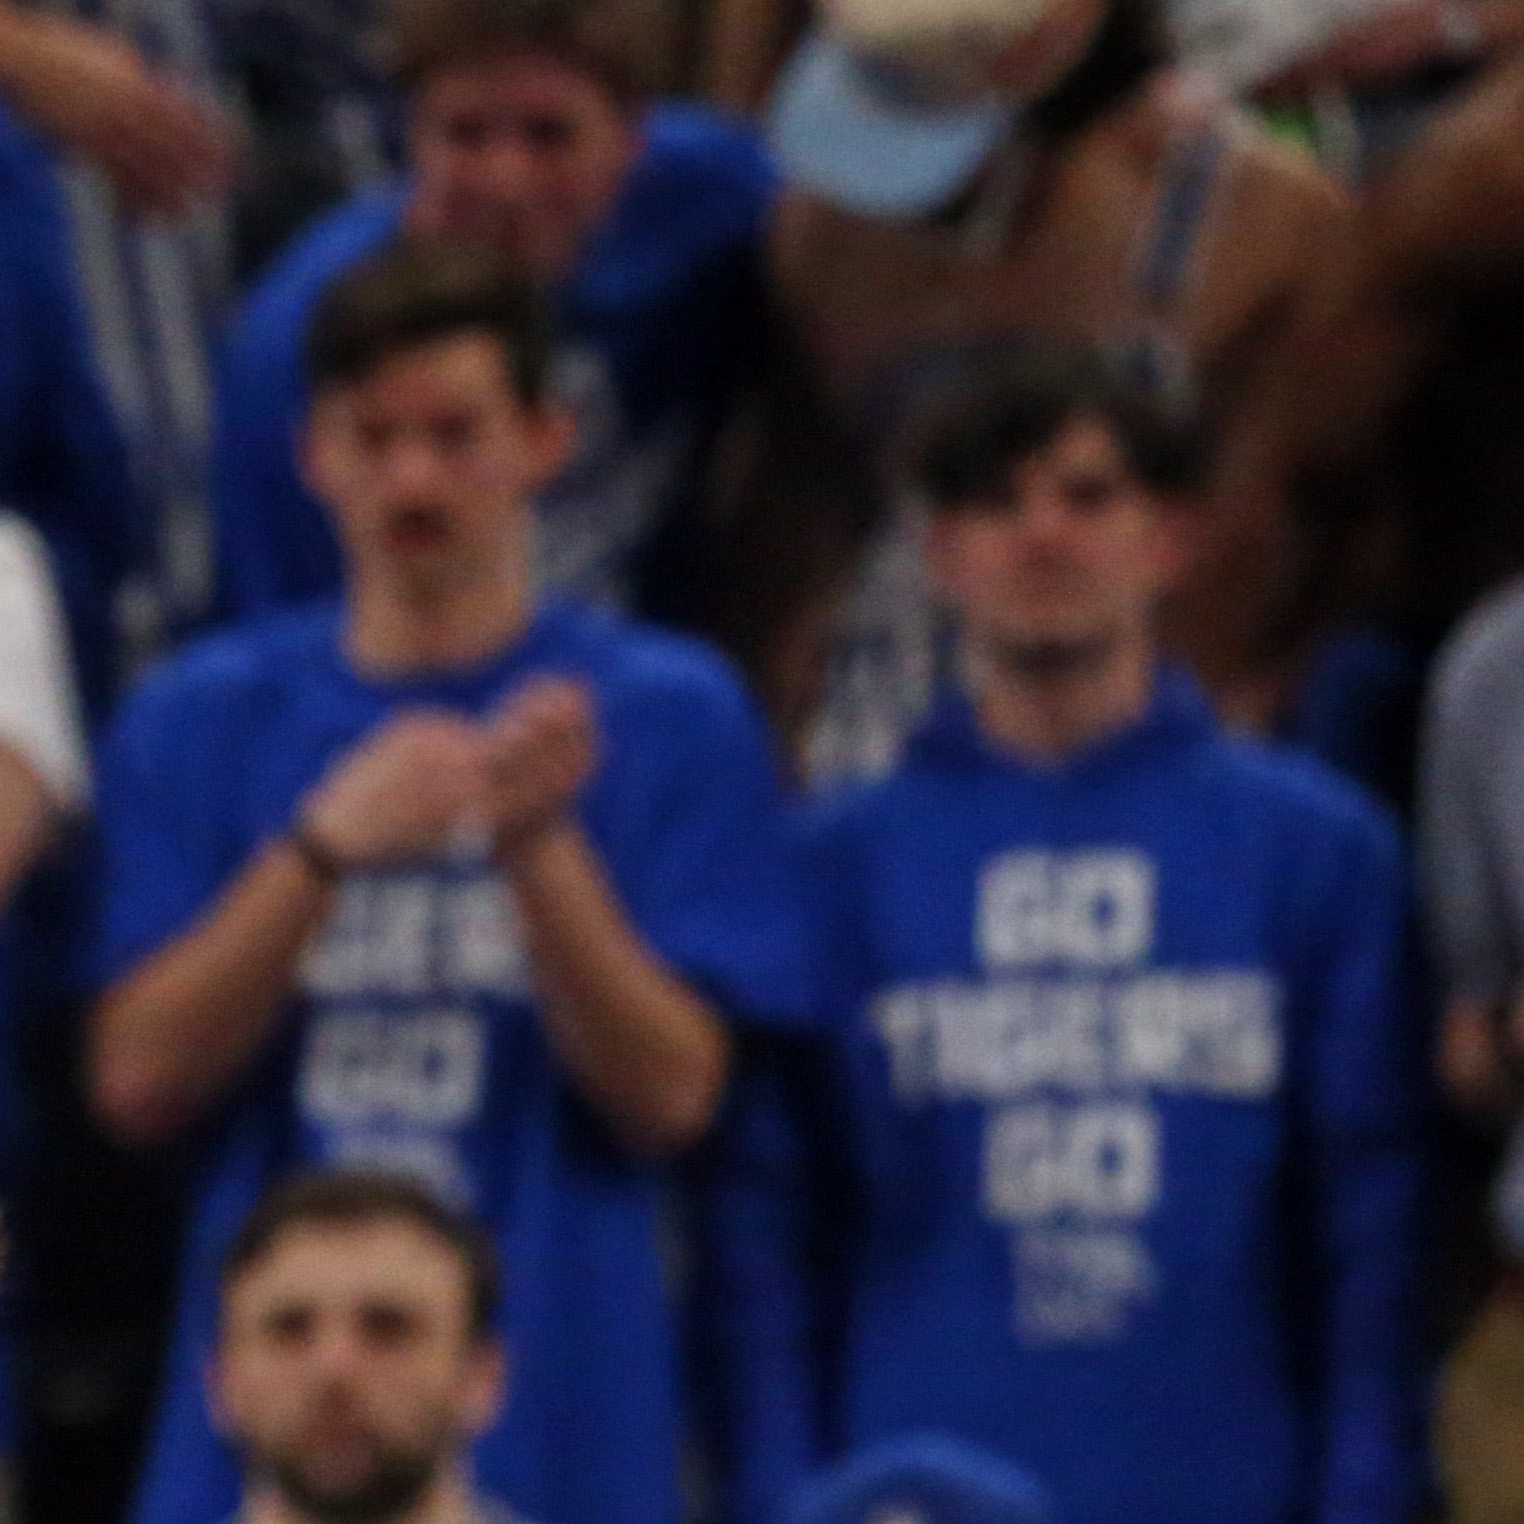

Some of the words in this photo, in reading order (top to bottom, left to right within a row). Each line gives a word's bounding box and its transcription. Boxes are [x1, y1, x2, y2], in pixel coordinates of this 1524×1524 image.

[974, 845, 1158, 967] GO
[298, 1005, 488, 1123] GO
[869, 968, 1286, 1105] TIGERS
[983, 1103, 1163, 1222] GO
